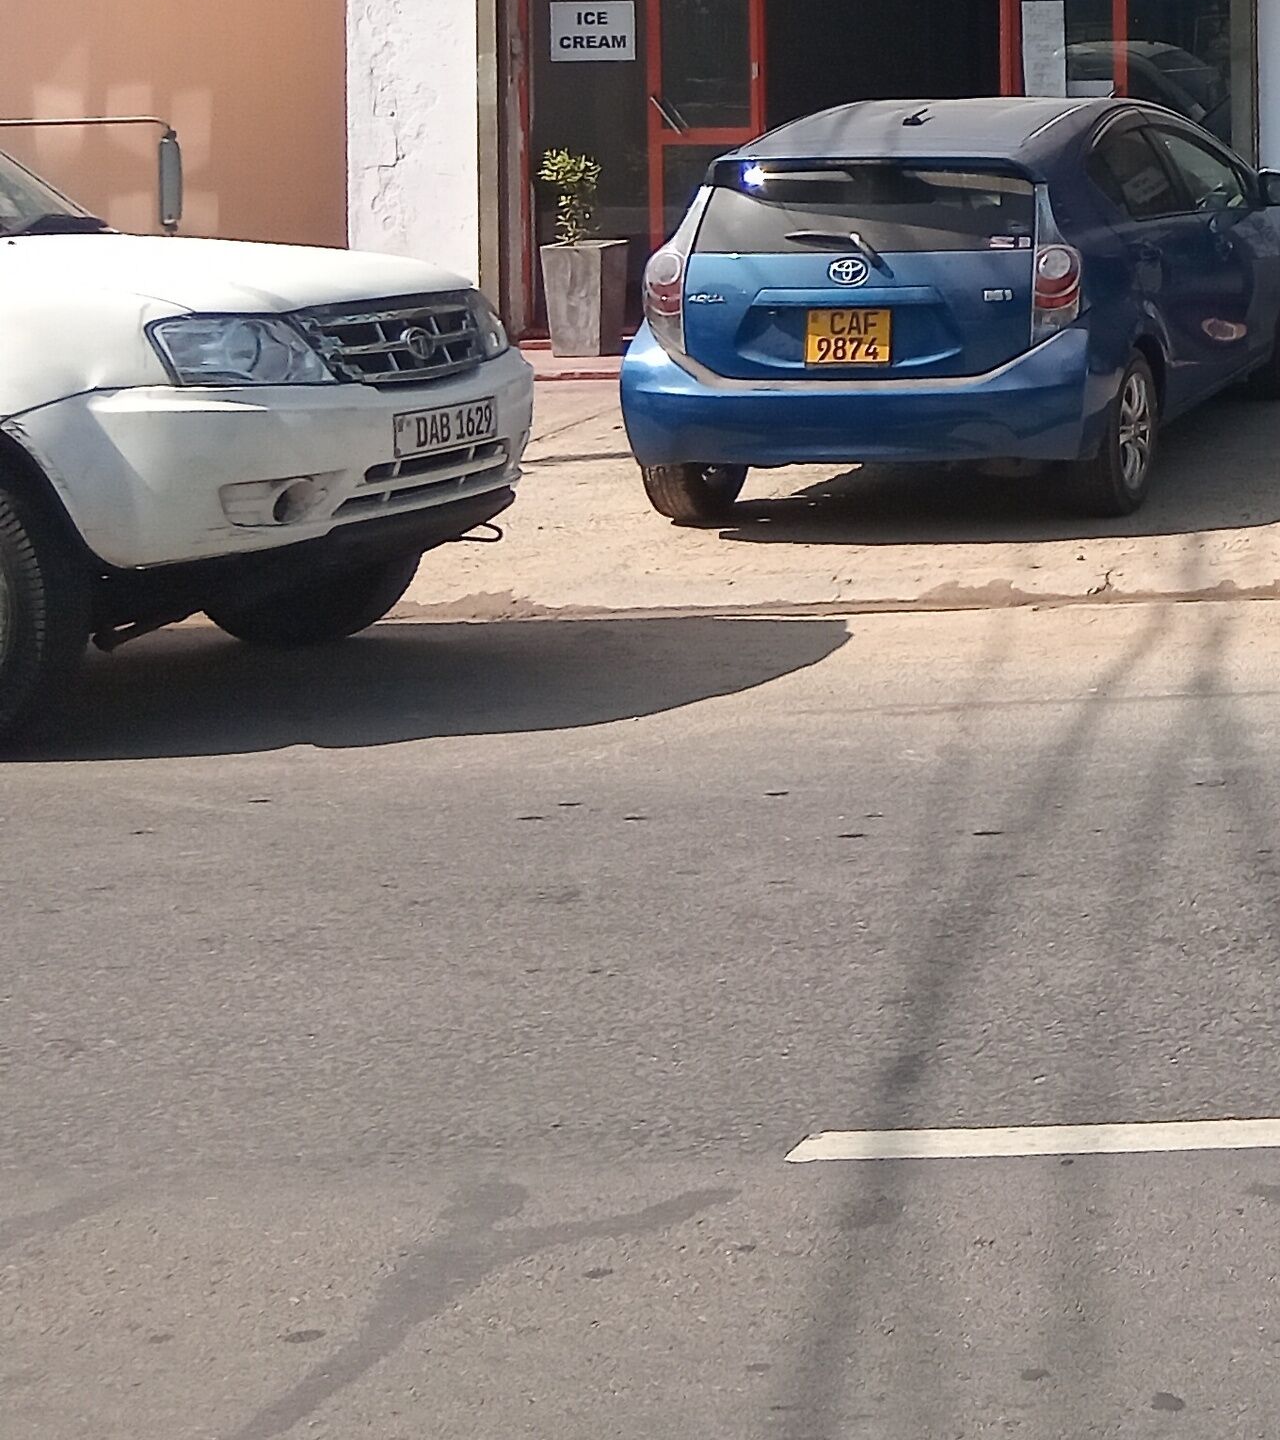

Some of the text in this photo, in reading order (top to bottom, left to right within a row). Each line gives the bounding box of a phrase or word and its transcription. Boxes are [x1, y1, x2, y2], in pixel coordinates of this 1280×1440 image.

[576, 11, 608, 26] ICE
[559, 34, 627, 49] CREAM
[829, 311, 879, 335] CAF
[816, 336, 880, 361] 9874
[415, 405, 493, 449] DAB 1629
